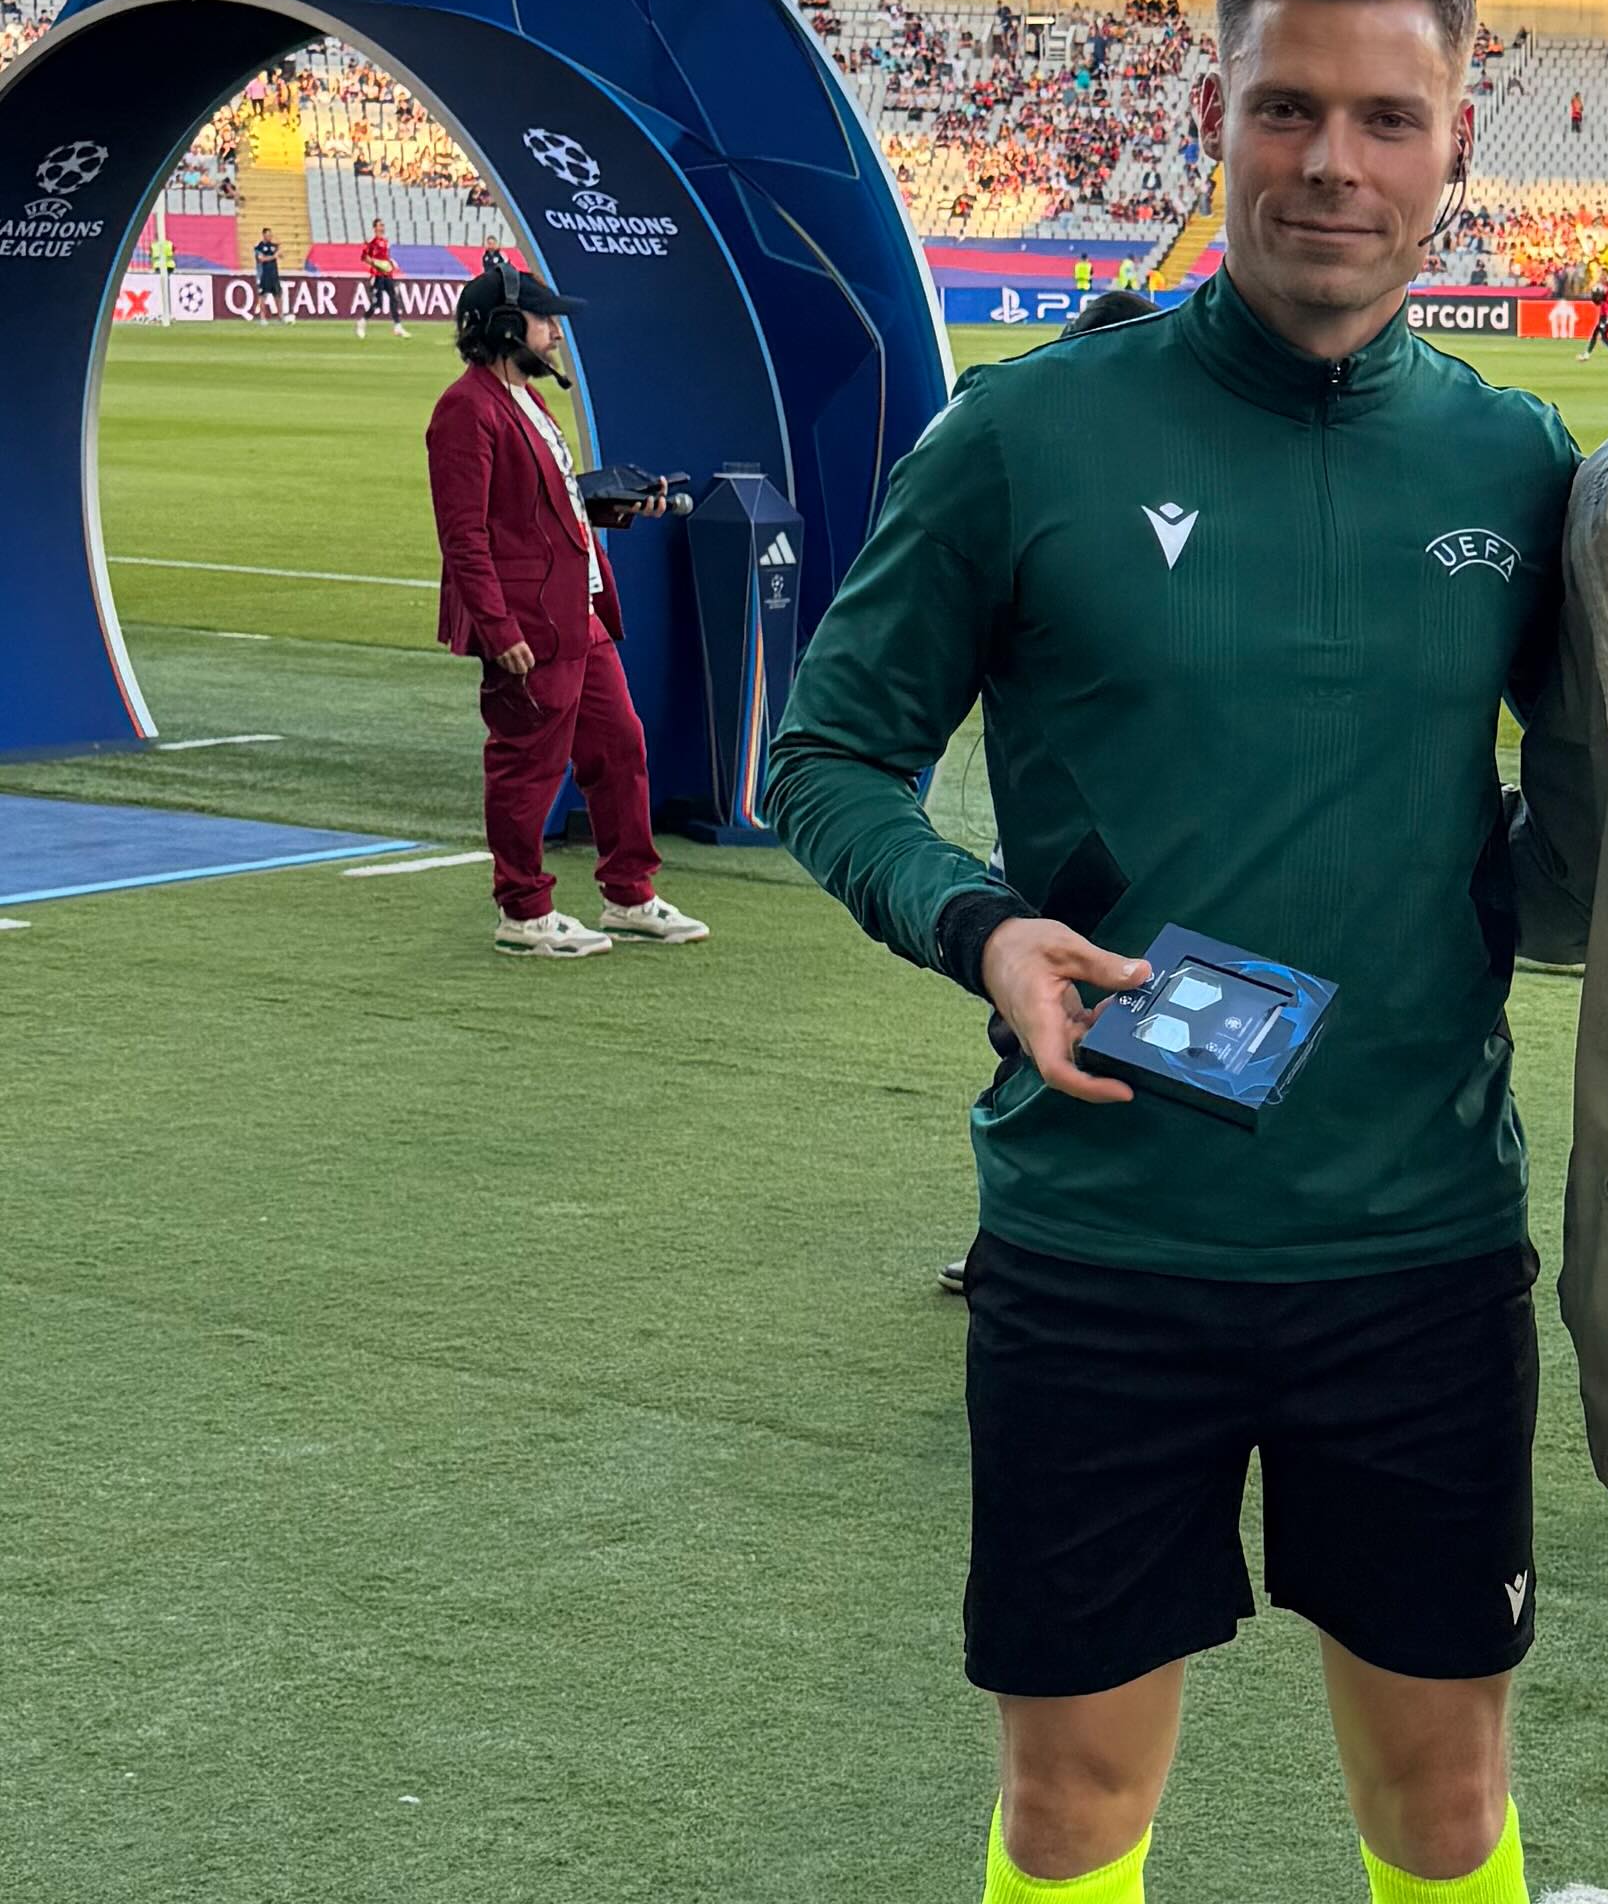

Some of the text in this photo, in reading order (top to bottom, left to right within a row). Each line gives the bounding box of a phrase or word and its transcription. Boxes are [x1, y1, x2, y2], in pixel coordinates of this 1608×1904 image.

[0, 220, 104, 238] AMPIONS
[545, 210, 678, 235] CHAMPIONS
[0, 240, 75, 257] EAGUE
[577, 233, 667, 256] LEAGUE
[1407, 301, 1509, 330] ercard
[1431, 533, 1517, 577] UEFA
